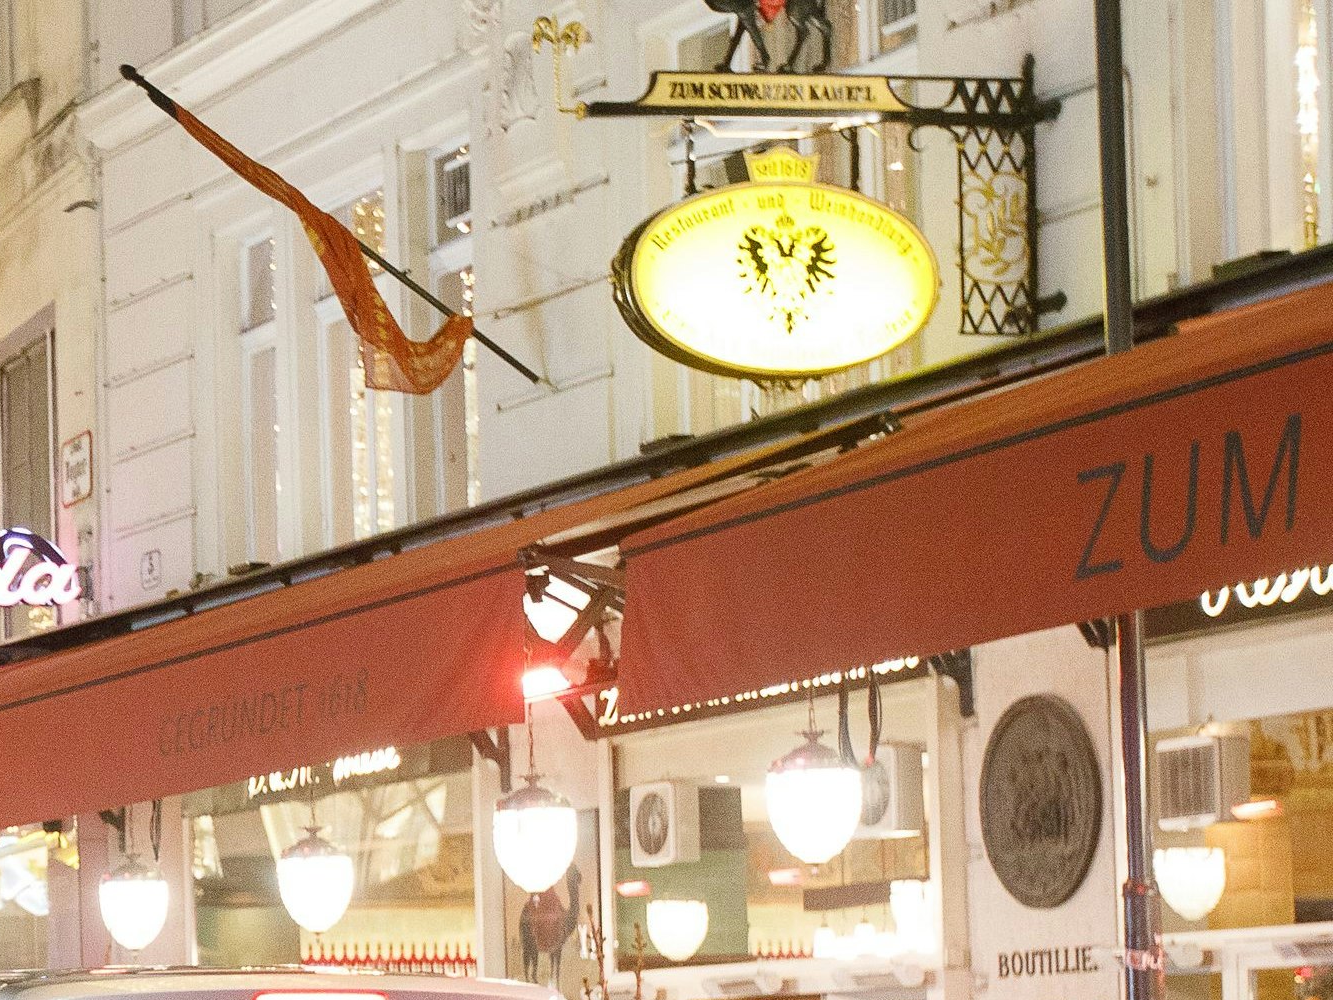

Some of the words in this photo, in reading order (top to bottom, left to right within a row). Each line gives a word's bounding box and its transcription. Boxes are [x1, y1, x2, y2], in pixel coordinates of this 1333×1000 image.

[669, 80, 704, 100] ZUM
[708, 81, 804, 101] SCHWARZEN
[1074, 413, 1302, 581] ZUM
